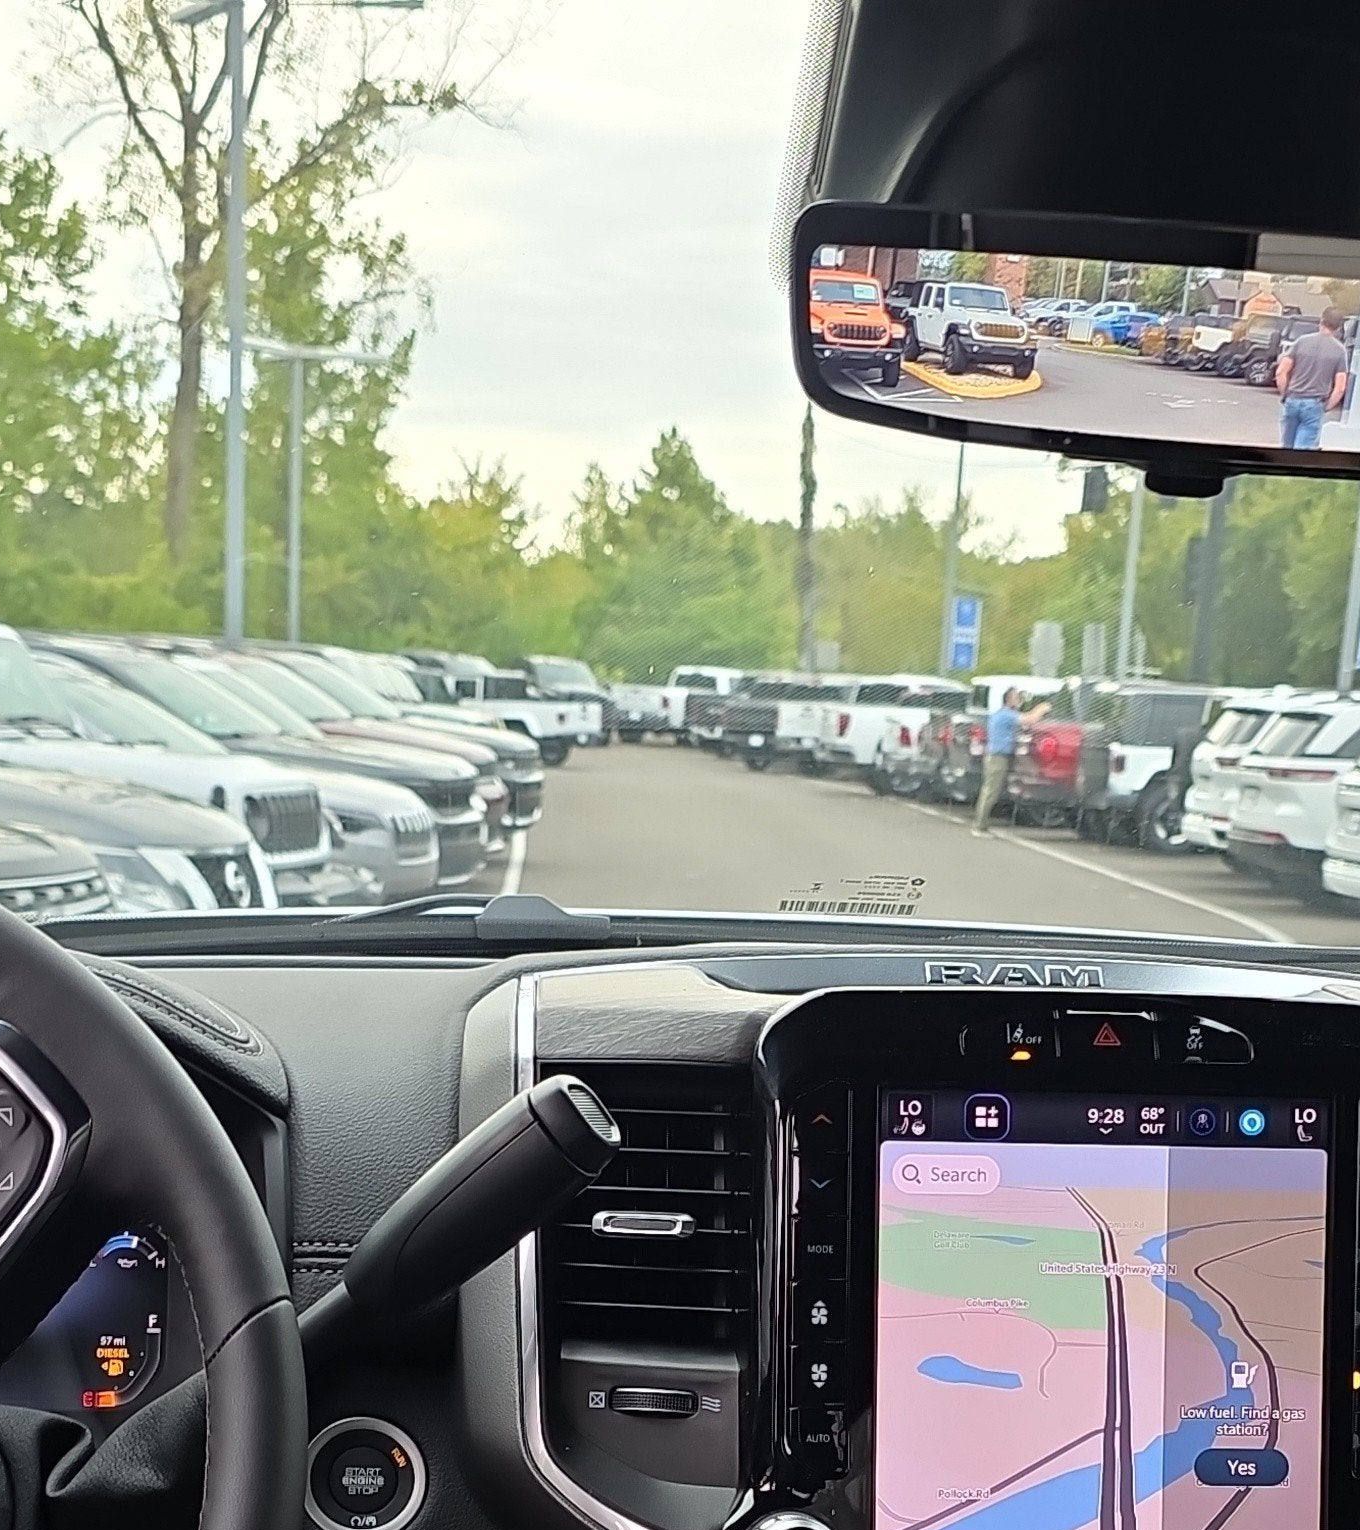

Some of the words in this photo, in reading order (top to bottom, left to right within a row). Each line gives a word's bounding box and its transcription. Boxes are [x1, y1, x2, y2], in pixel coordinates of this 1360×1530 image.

[924, 961, 1105, 988] RAM
[1026, 1036, 1042, 1045] OFF
[899, 1100, 923, 1116] LO
[1087, 1108, 1125, 1125] 9:28
[1294, 1108, 1318, 1124] LO
[1139, 1123, 1166, 1135] OUT
[930, 1166, 988, 1183] Search
[933, 1230, 970, 1239] Delaware
[807, 1244, 835, 1254] MODE
[933, 1240, 950, 1249] Golf
[951, 1241, 970, 1249] Club
[1040, 1263, 1073, 1274] United
[1076, 1263, 1105, 1274] States
[1108, 1263, 1150, 1276] Highway
[1153, 1264, 1165, 1274] 23
[1168, 1264, 1177, 1274] N
[965, 1298, 1009, 1308] Columbus
[1010, 1298, 1029, 1308] Pike
[148, 1314, 159, 1328] F
[1180, 1406, 1207, 1419] Low
[1209, 1405, 1238, 1420] fuel.
[1241, 1406, 1269, 1420] Find
[1272, 1409, 1280, 1420] a
[1282, 1409, 1306, 1422] gas
[1216, 1423, 1269, 1436] station?
[806, 1433, 831, 1443] AUTO
[345, 1467, 382, 1477] START
[1227, 1459, 1257, 1476] Yes
[341, 1476, 385, 1486] ENGINE
[348, 1486, 379, 1495] STOP
[938, 1489, 974, 1499] Pollock
[976, 1489, 989, 1499] Rd
